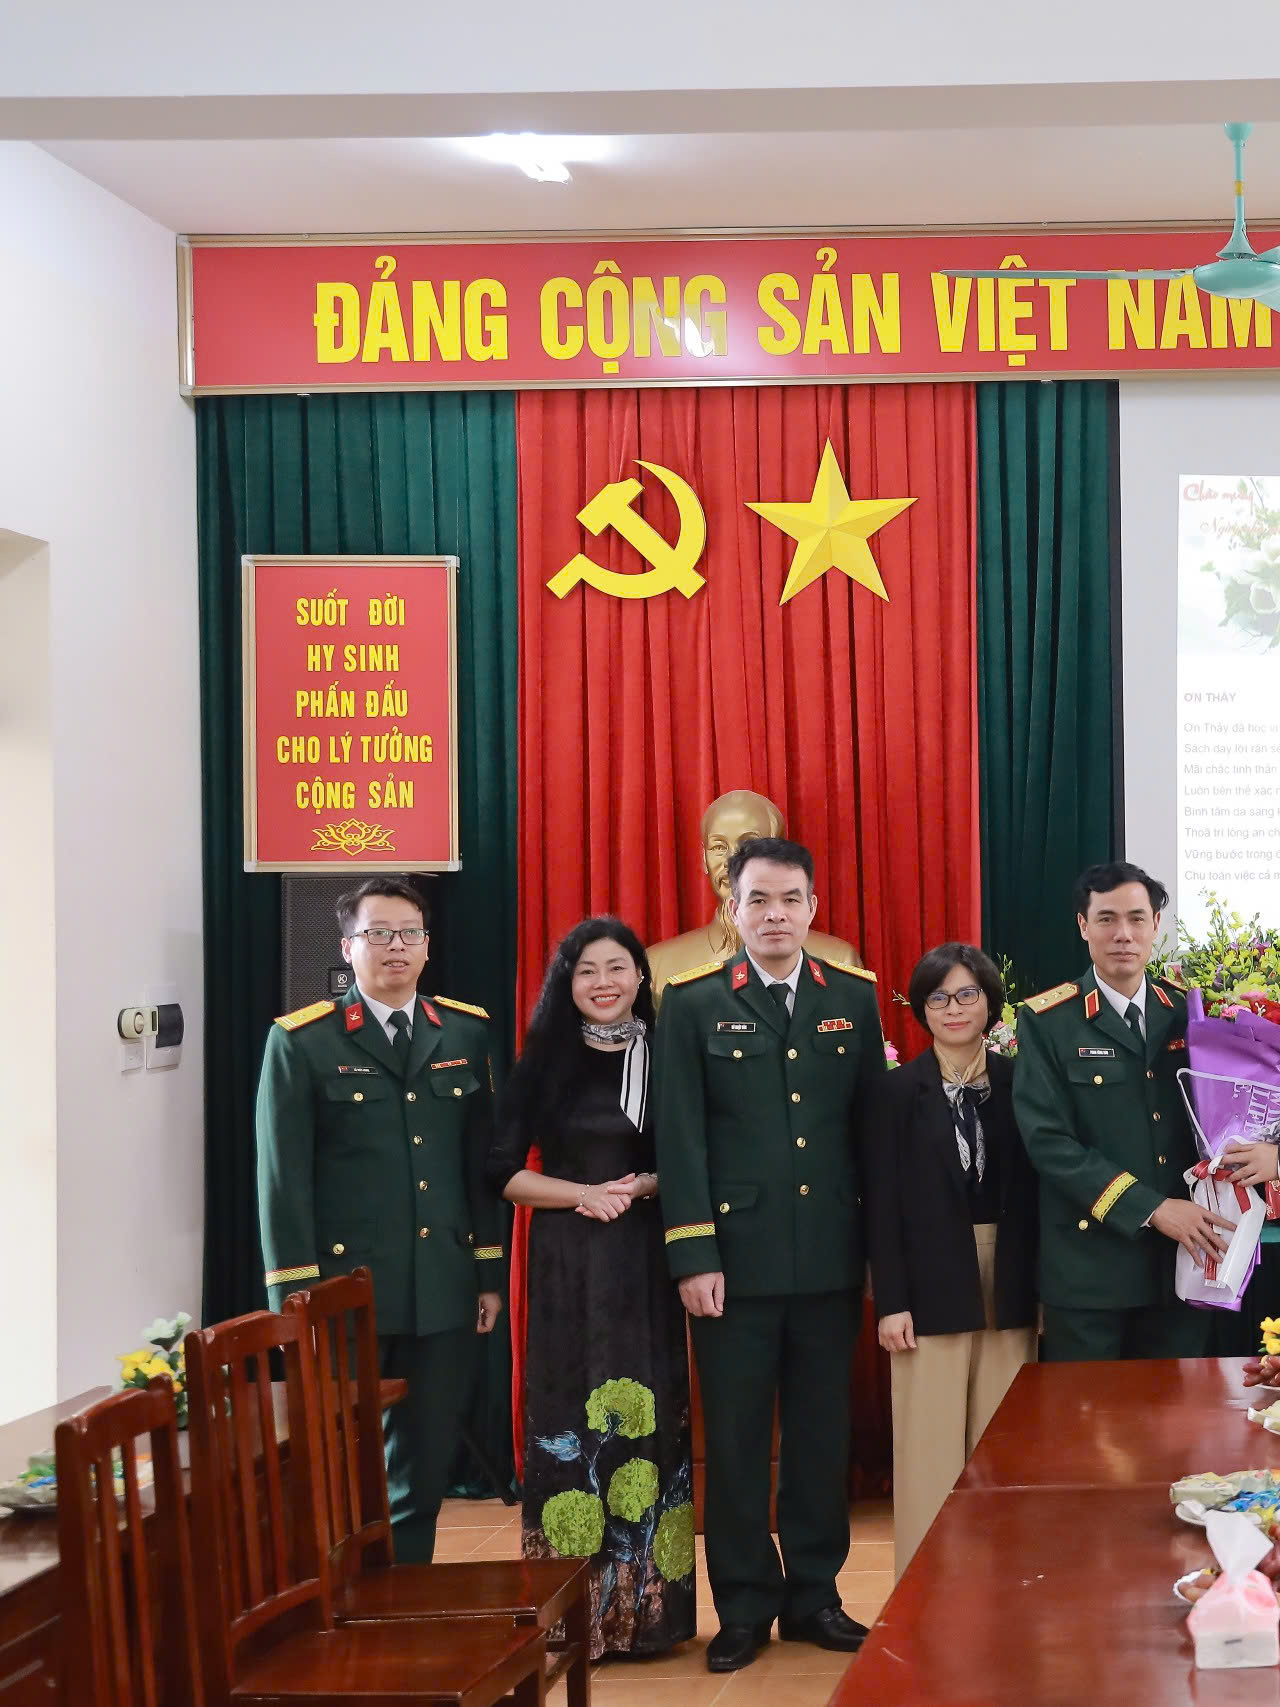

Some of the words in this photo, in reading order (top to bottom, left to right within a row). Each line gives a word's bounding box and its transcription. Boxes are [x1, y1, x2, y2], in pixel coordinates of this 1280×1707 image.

[313, 255, 509, 364] ĐẢNG
[539, 260, 727, 374] CỘNG
[757, 247, 901, 354] SẢN
[930, 254, 1077, 367] VIỆT
[1107, 268, 1273, 350] NAM
[296, 588, 349, 627] SUỐT
[368, 593, 406, 627] ĐỜI
[307, 644, 336, 672] HY
[343, 644, 400, 672] SINH
[296, 680, 356, 718] PHẤN
[365, 680, 409, 718] ĐẤU
[276, 736, 320, 764] CHO
[328, 731, 353, 764] LÝ
[360, 726, 434, 764] TƯỞNG
[295, 776, 356, 815] CỘNG
[368, 773, 415, 809] SẢN
